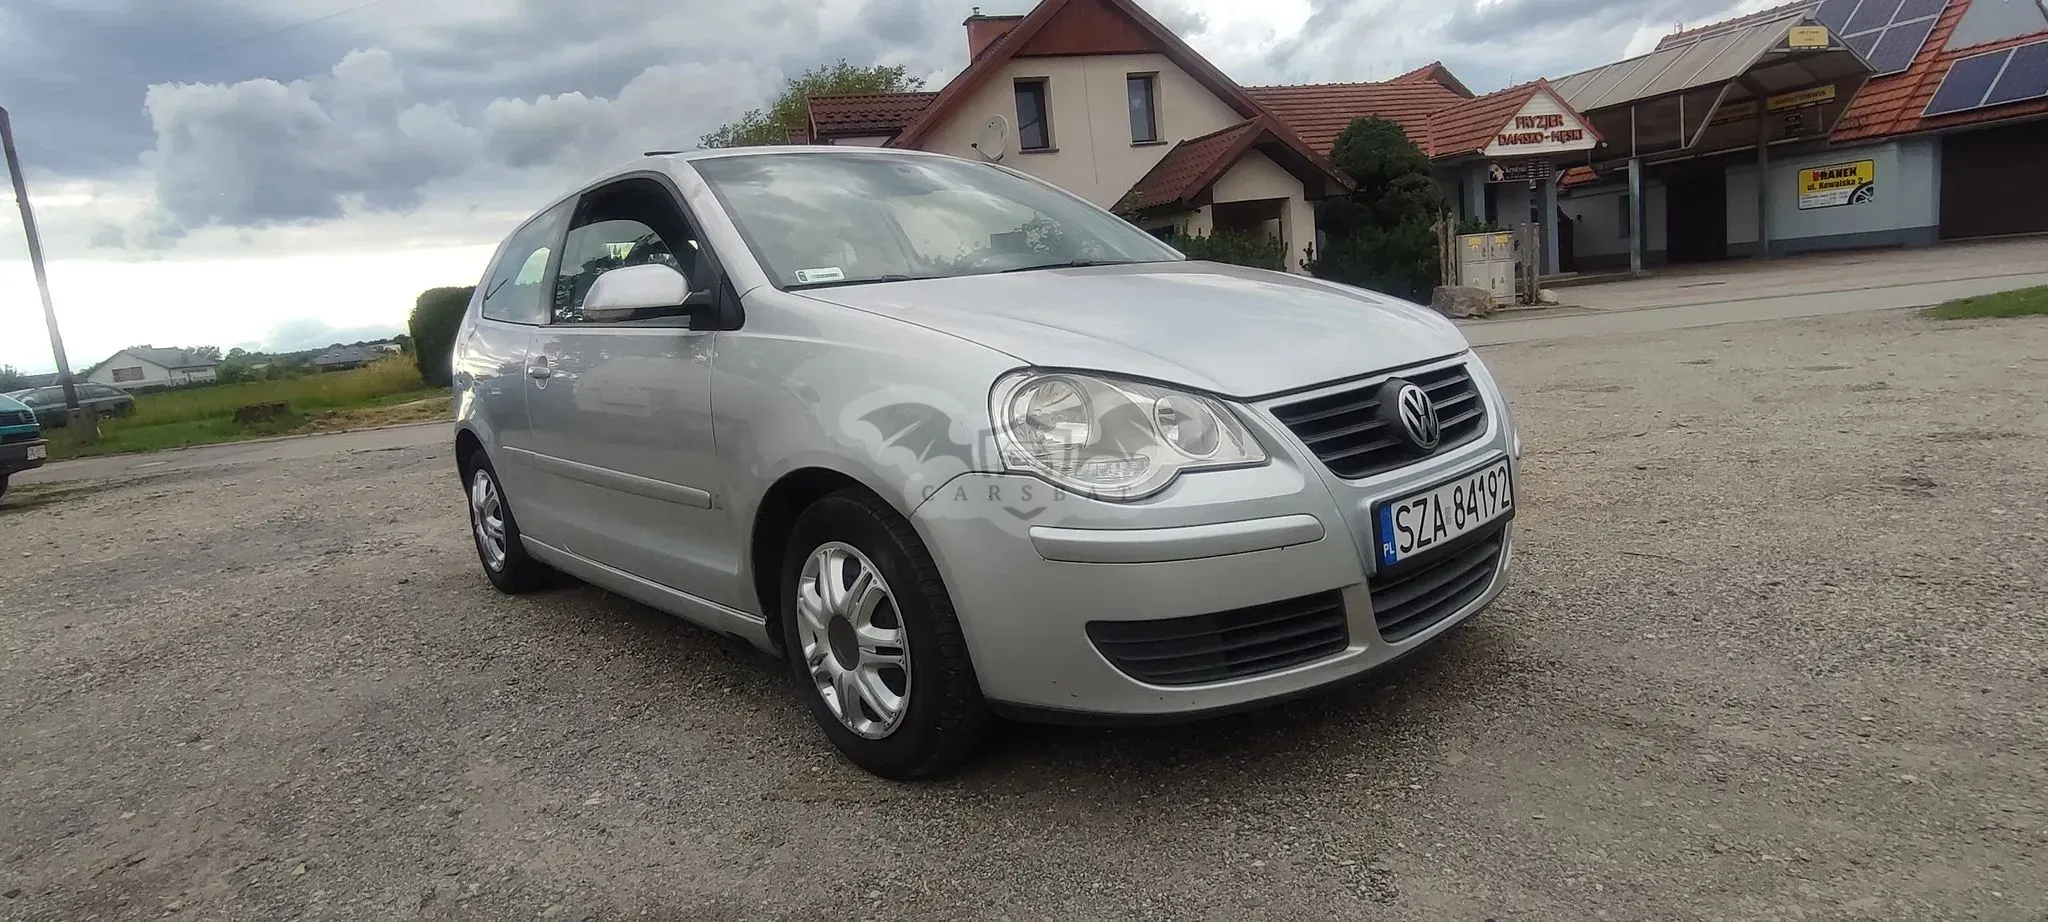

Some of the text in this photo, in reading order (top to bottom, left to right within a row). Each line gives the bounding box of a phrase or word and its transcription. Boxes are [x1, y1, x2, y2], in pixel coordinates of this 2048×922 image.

[1515, 114, 1564, 130] FRYZJER
[1857, 176, 1863, 185] 2
[1395, 465, 1510, 554] SZA 84192
[1383, 543, 1395, 557] PL
